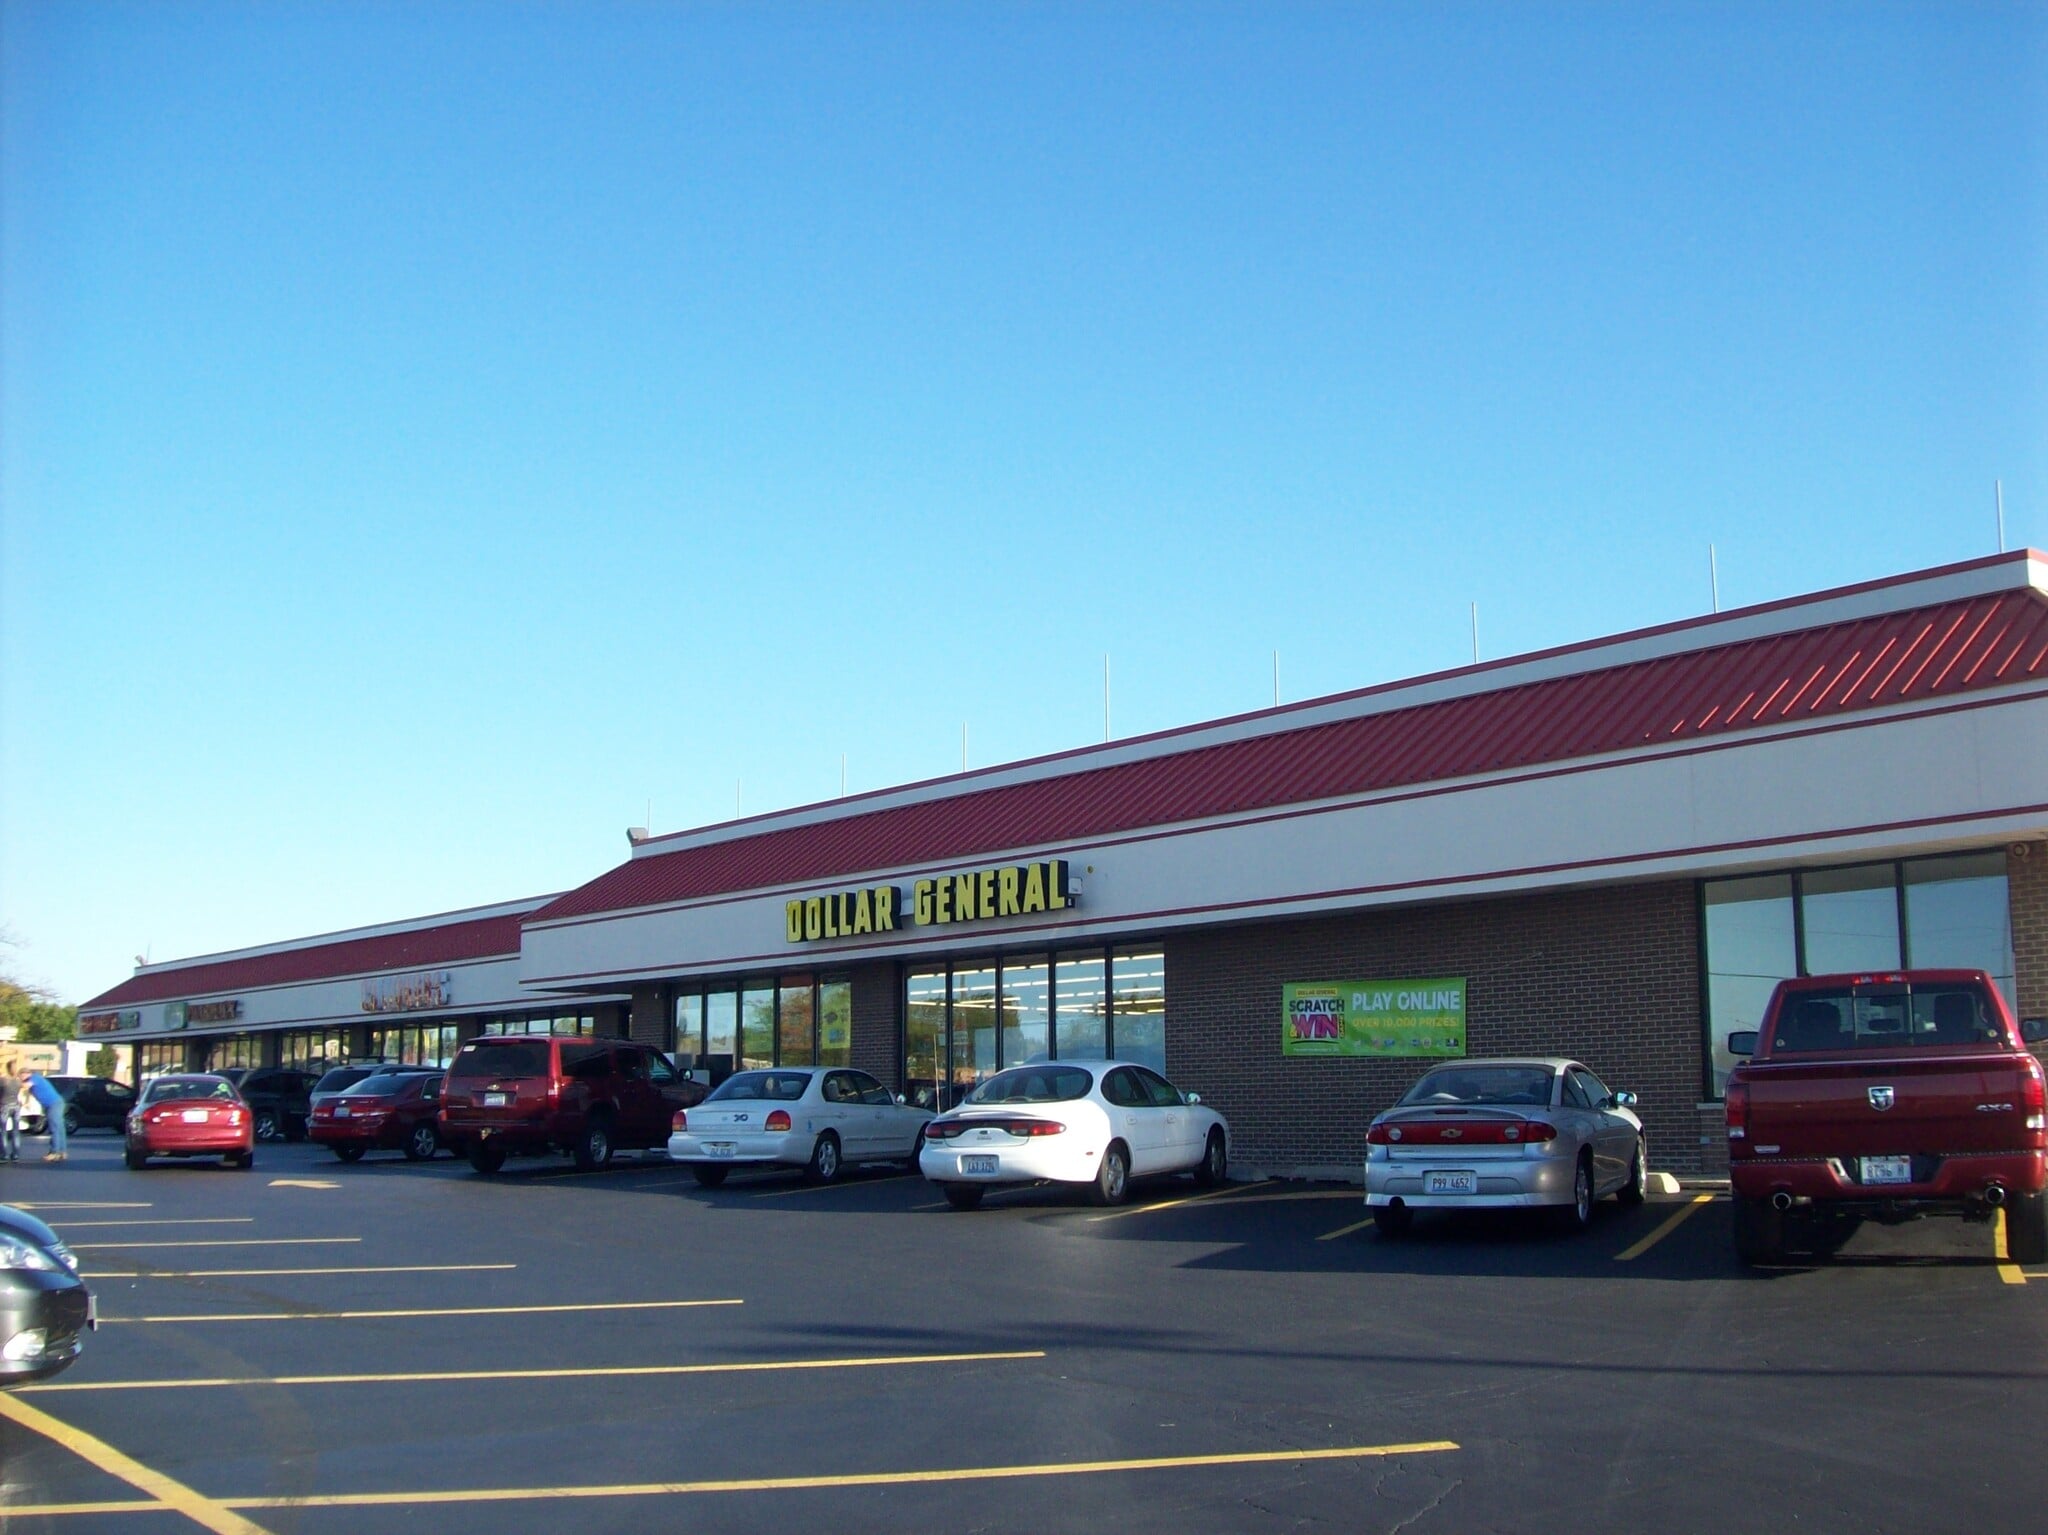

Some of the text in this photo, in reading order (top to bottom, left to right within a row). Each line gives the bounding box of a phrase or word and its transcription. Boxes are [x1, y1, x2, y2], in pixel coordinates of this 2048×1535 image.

[786, 886, 901, 943] DOLLAR
[1289, 999, 1344, 1012] SCRATCH
[1352, 991, 1460, 1011] PLAY ONLINE
[1291, 1014, 1338, 1038] WIN
